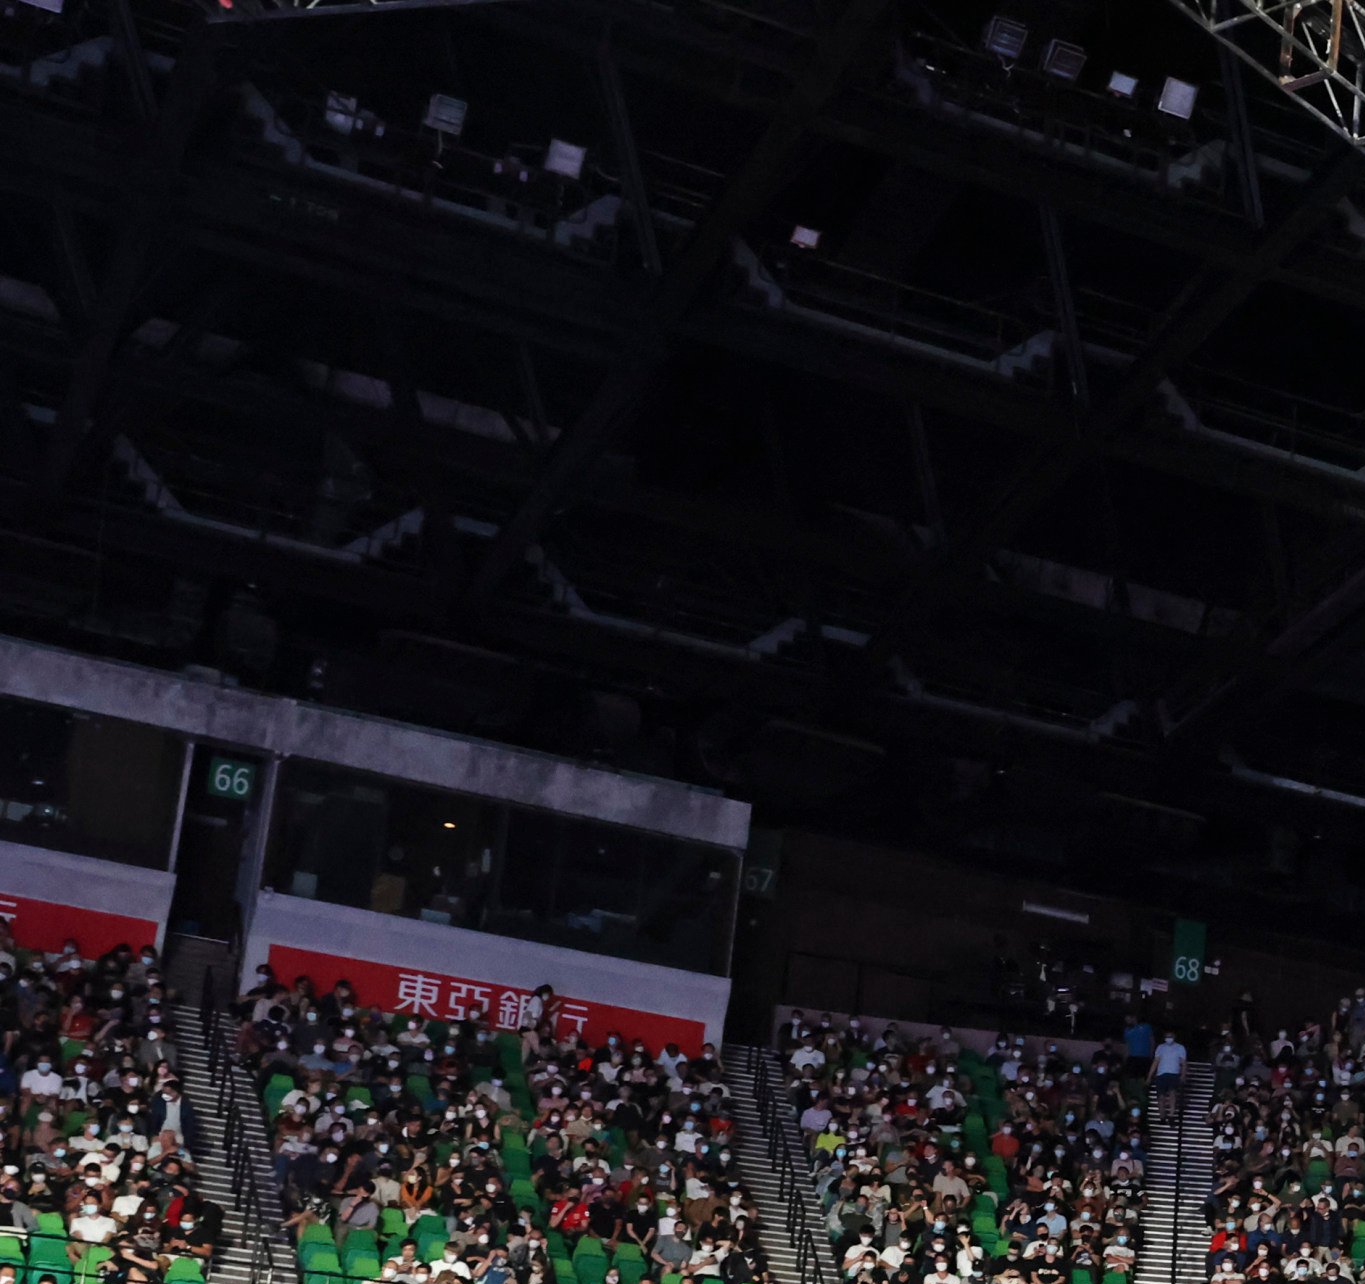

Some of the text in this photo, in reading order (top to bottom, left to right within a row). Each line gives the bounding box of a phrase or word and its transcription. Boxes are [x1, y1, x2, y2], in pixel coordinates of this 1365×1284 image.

[214, 764, 250, 795] 66
[745, 867, 774, 893] 67
[1174, 956, 1200, 983] 68
